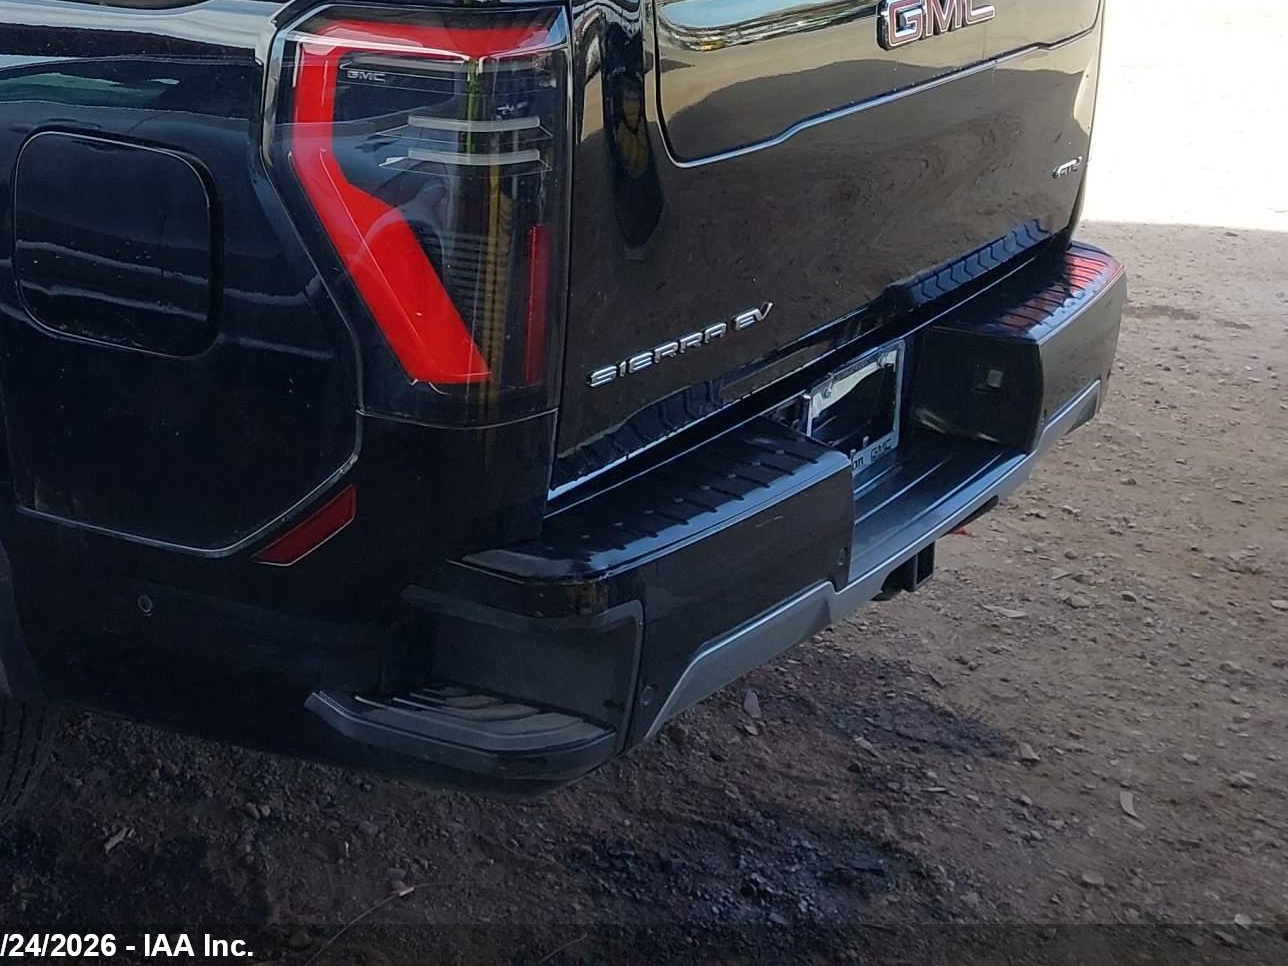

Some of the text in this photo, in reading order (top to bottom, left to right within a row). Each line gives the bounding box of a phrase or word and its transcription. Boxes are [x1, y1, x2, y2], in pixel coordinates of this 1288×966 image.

[347, 70, 386, 82] GMC
[590, 302, 773, 387] SIERRA EV
